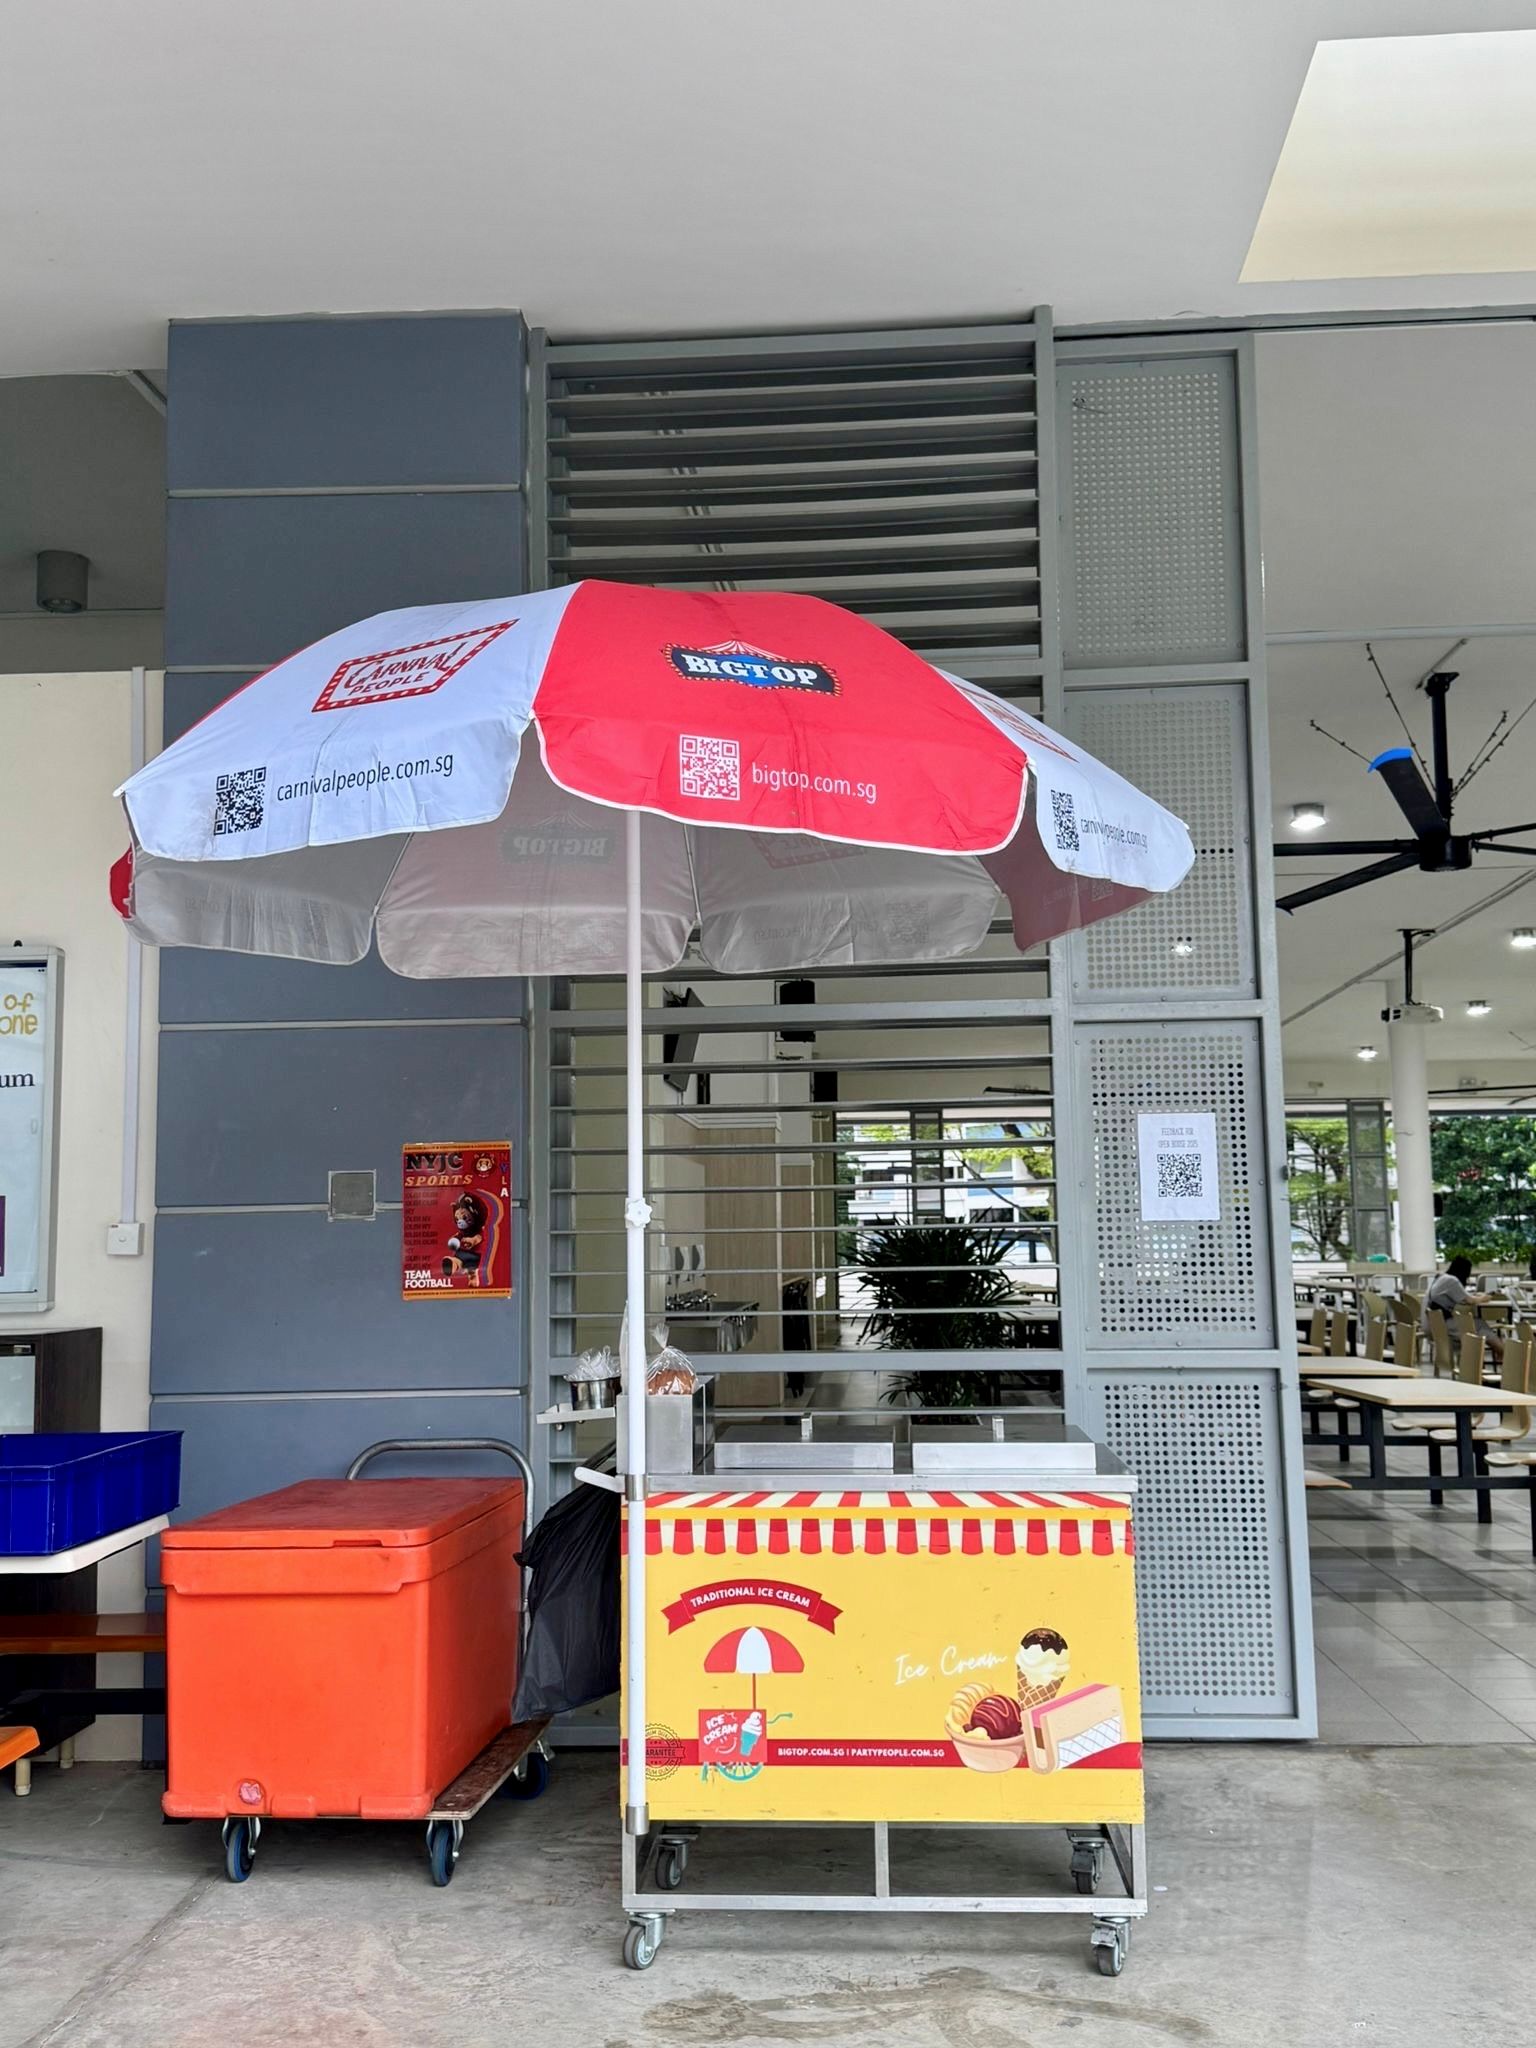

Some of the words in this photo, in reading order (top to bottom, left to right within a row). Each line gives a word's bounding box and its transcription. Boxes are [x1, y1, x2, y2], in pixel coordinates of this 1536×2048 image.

[344, 642, 468, 689] CARNIVAL
[681, 653, 818, 686] BIGTOP
[348, 672, 430, 696] PEOPLE
[276, 753, 453, 801] carnivalpeople.com.sg
[751, 761, 877, 804] bigtop.com.sg
[4, 992, 34, 1012] of
[405, 1152, 463, 1174] NYJC
[404, 1174, 473, 1187] SPORTS
[405, 1270, 432, 1279] TEAM
[405, 1279, 453, 1288] FOOTBALL
[690, 1587, 756, 1607] TRADITIONAL
[757, 1588, 774, 1598] ICE
[775, 1589, 811, 1608] CREAM
[895, 1654, 929, 1685] Ice
[940, 1645, 1008, 1676] Cream
[705, 1714, 726, 1730] ICE
[703, 1723, 738, 1745] CREAM
[777, 1747, 845, 1757] BIGTOP.COM.SG
[851, 1747, 945, 1758] PARTYPEOPLE.COM.SG
